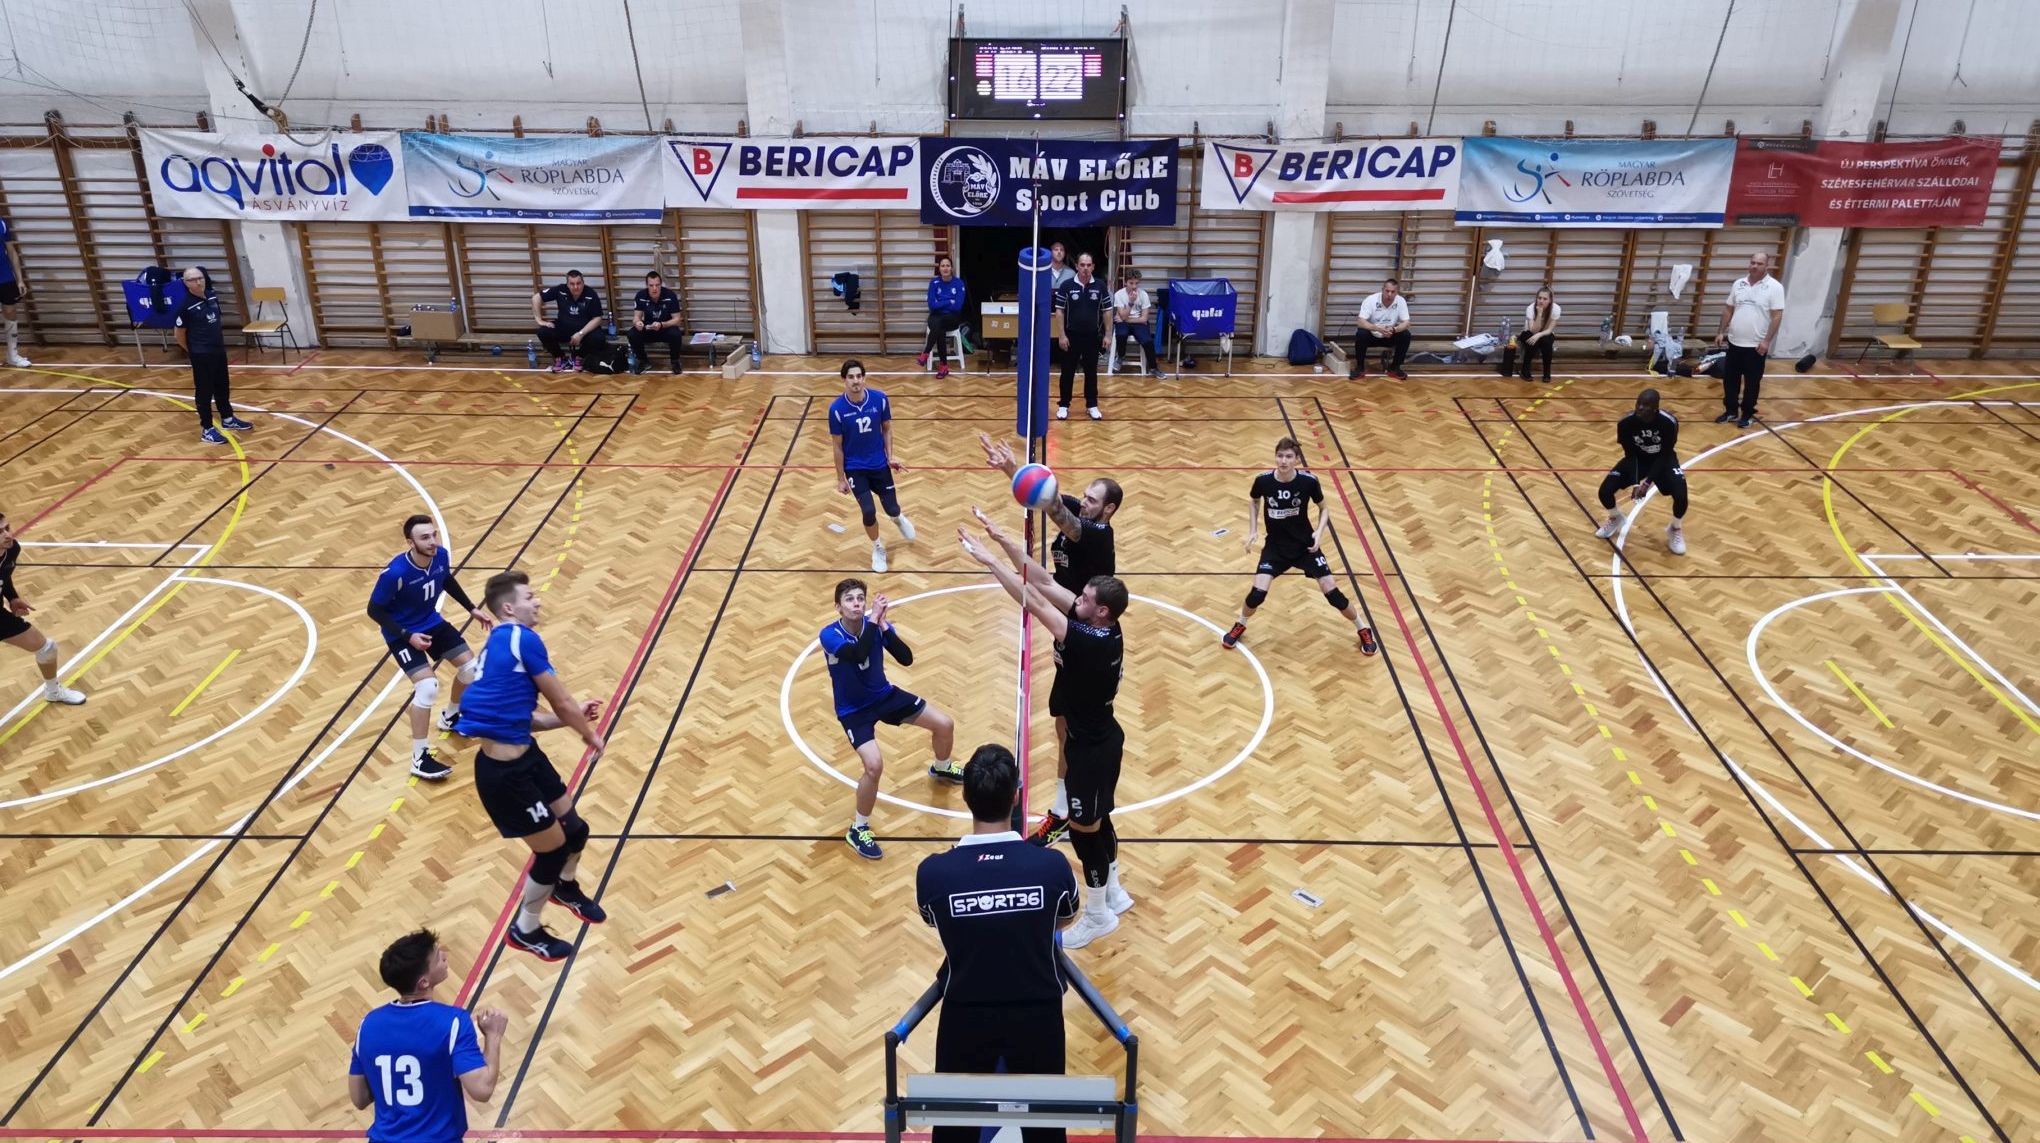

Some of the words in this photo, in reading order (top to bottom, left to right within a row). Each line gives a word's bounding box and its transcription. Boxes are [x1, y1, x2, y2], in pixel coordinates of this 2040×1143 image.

[552, 159, 588, 167] MAGYAR
[693, 148, 714, 175] B
[739, 145, 914, 177] BERICAP
[1009, 151, 1068, 180] MÁV
[1079, 152, 1169, 181] ELŐRE
[1234, 153, 1253, 178] B
[1278, 145, 1456, 181] BERICAP
[1618, 160, 1656, 168] MAGYAR
[1840, 158, 1855, 169] ÚJ
[1856, 157, 1928, 169] PERSPEKTÍVA
[161, 143, 347, 210] aqvital
[520, 166, 624, 184] RÖPLABDA
[1581, 168, 1685, 187] RÖPLABDA
[1821, 177, 1916, 189] SZÉKESFEHÉRVÁR
[1916, 175, 1979, 187] SZÁLLODAI
[252, 197, 350, 211] ÁSVÁNYVÍZ
[1100, 188, 1160, 212] Club
[1829, 198, 1842, 209] ÉS
[1844, 198, 1889, 209] ÉTTERMI
[1891, 196, 1961, 208] PALETTÁJÁN
[1192, 307, 1223, 322] gala
[855, 416, 872, 433] 12
[1641, 429, 1653, 438] 13
[1277, 490, 1291, 500] 10
[1315, 556, 1327, 567] 10
[422, 579, 435, 601] 11
[398, 648, 412, 664] 11
[526, 800, 549, 823] 14
[1071, 797, 1082, 810] 2
[954, 891, 1040, 913] SPORT36
[375, 1055, 424, 1106] 13
